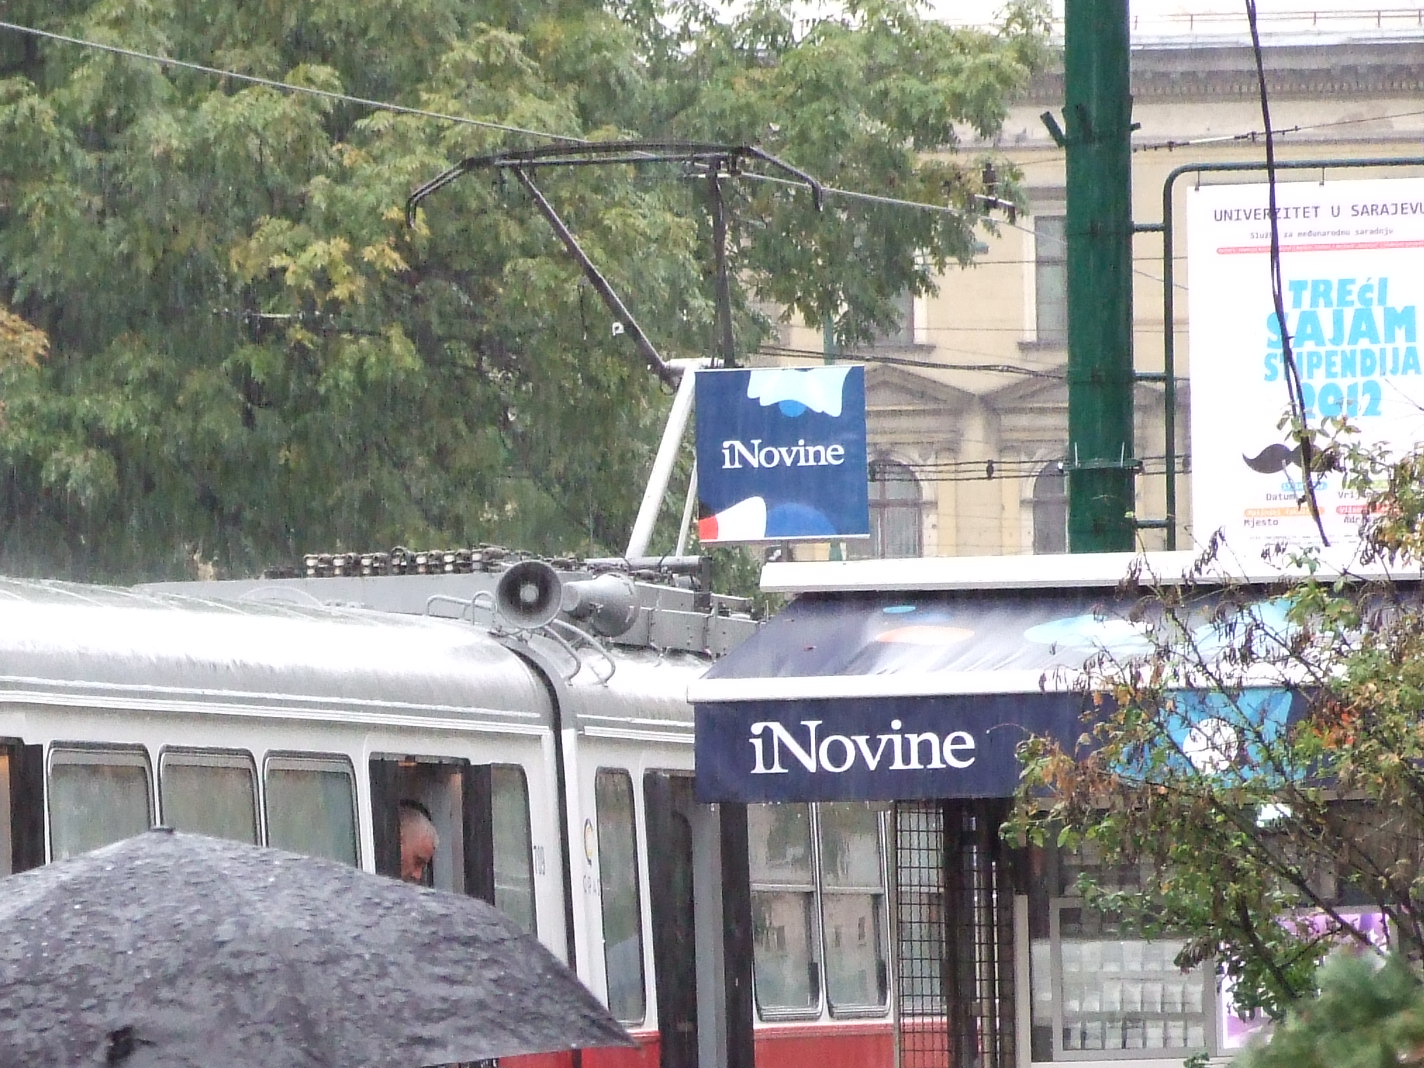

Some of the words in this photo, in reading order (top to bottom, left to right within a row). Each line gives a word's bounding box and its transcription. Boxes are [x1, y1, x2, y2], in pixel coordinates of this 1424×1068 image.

[1214, 205, 1321, 222] UNIVERZITET
[1331, 204, 1341, 218] U
[1266, 305, 1417, 349] SAJAM
[1298, 380, 1382, 419] 2012
[722, 439, 845, 469] iNovine
[1266, 492, 1297, 501] Datum
[1243, 518, 1279, 528] Mjesto
[749, 719, 976, 774] iNovine
